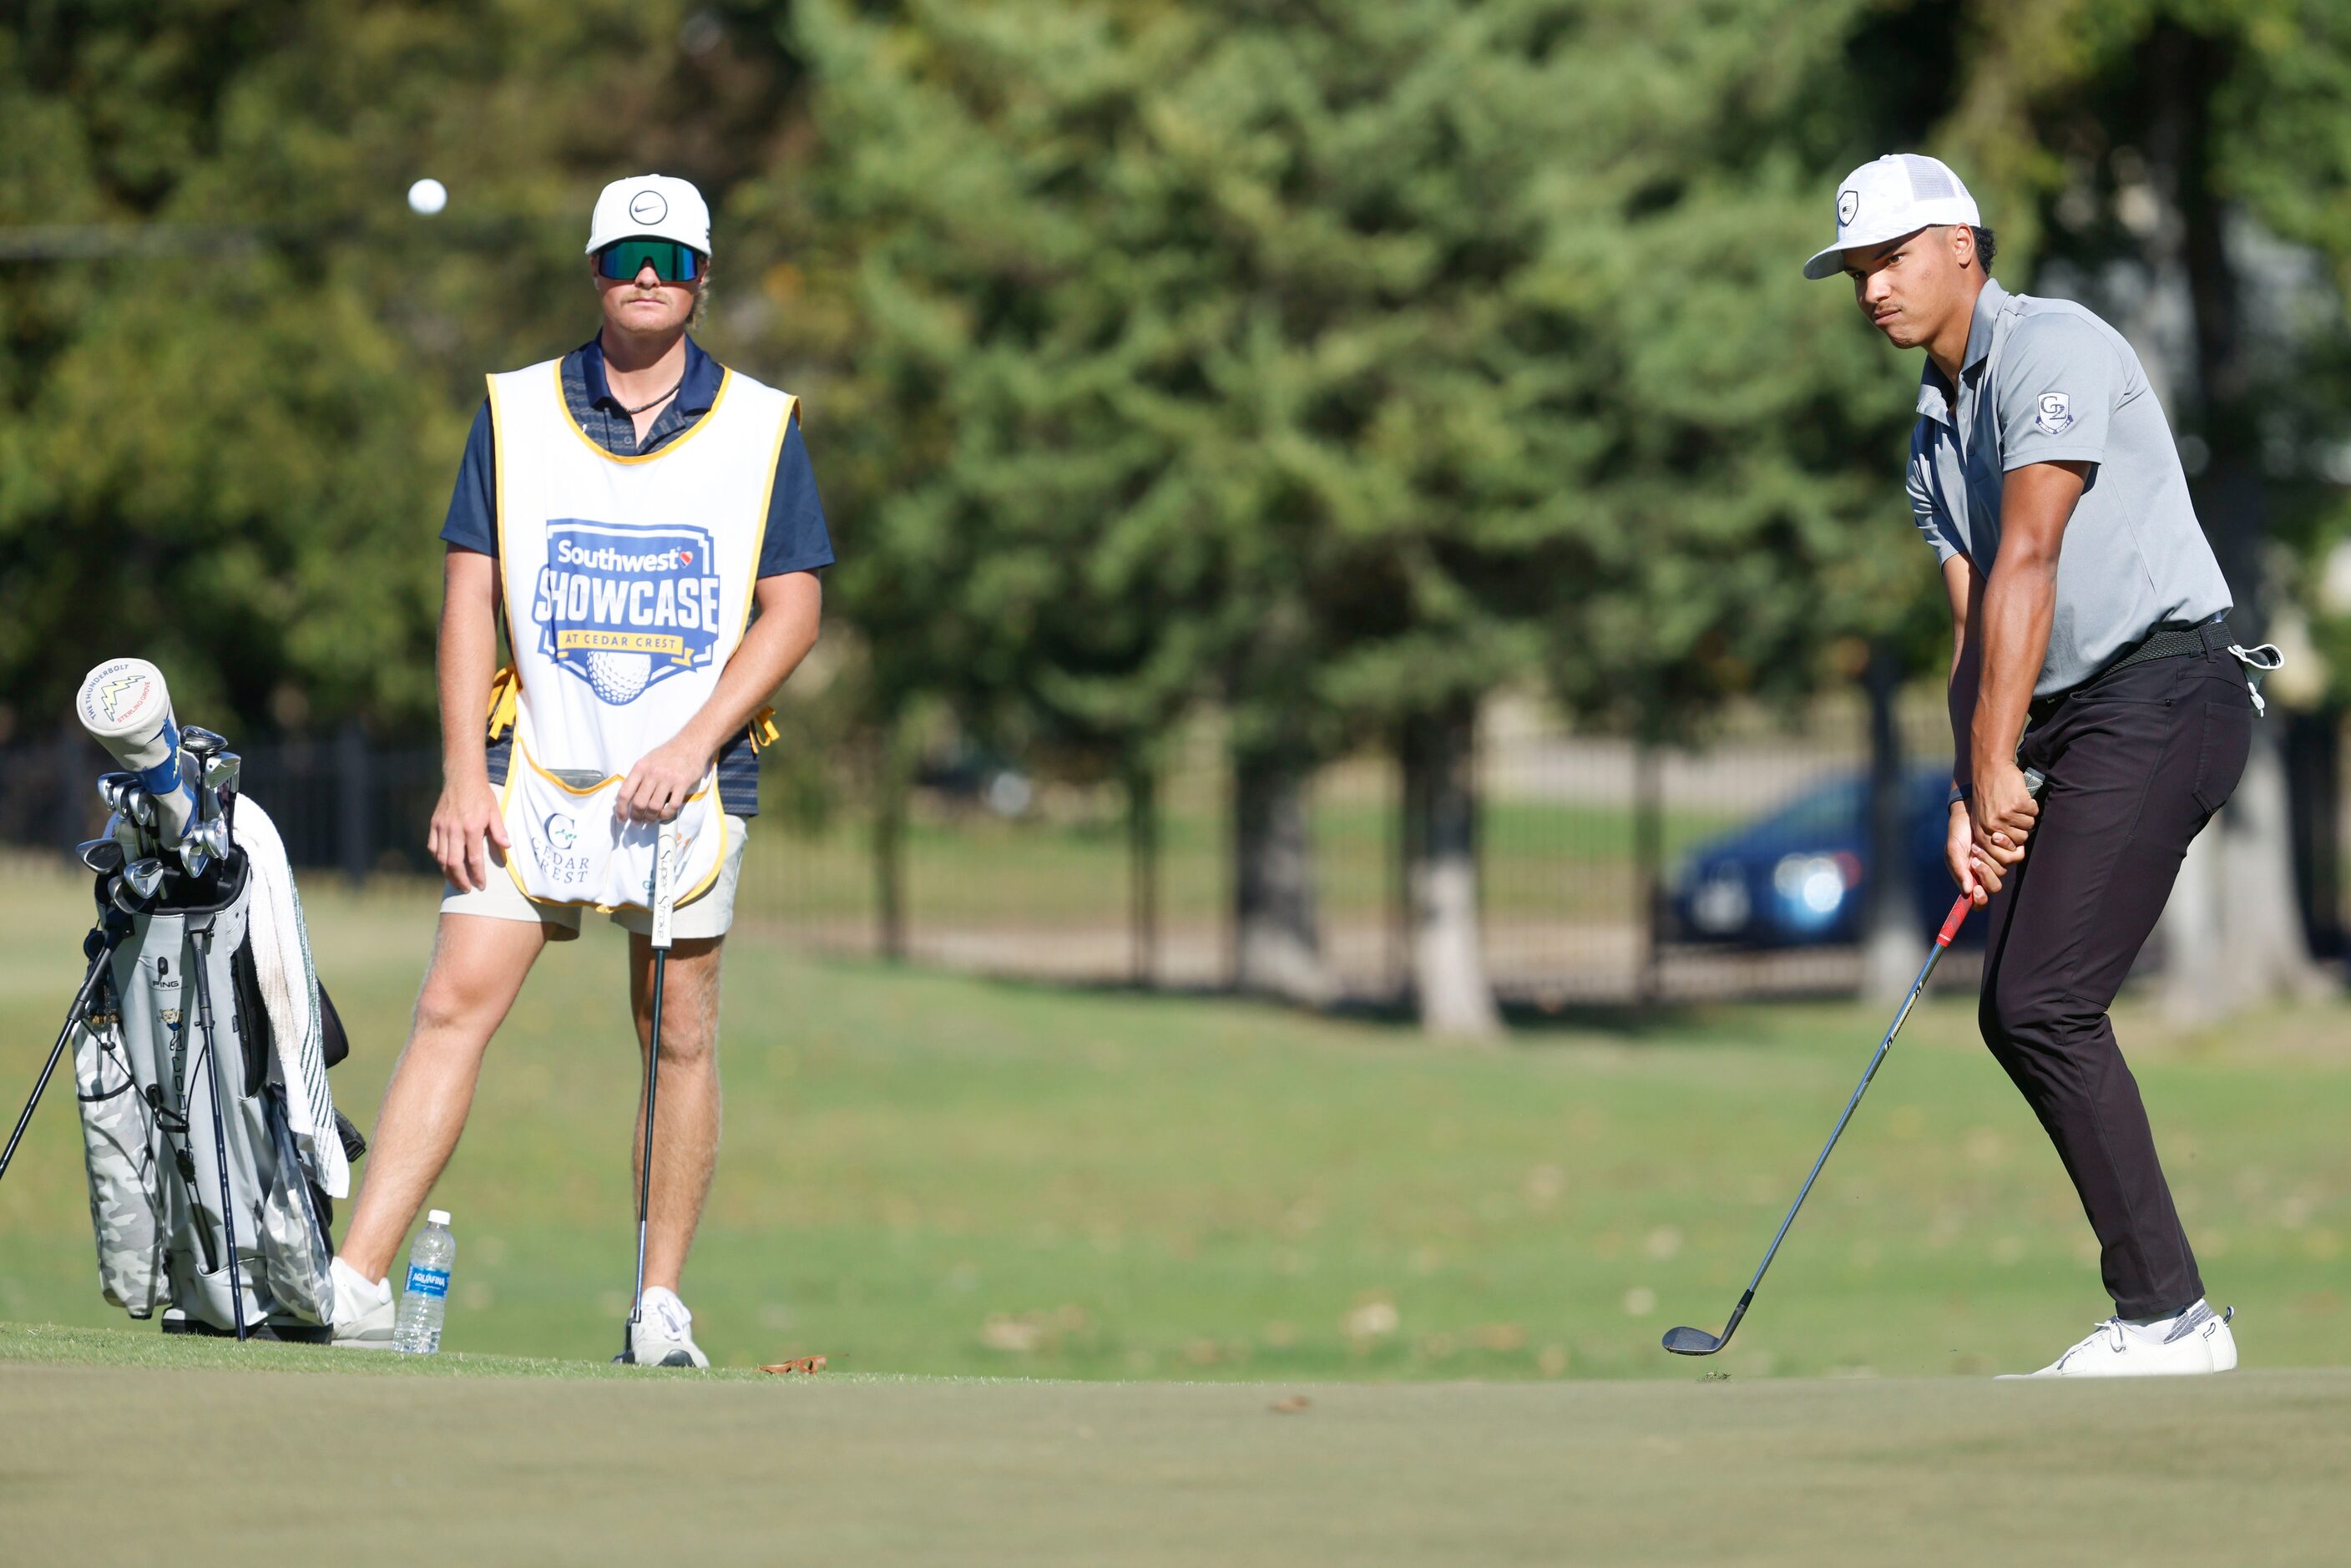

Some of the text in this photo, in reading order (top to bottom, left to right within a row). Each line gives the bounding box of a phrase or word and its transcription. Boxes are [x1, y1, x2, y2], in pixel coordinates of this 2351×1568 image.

[557, 539, 679, 573] Southwest
[534, 567, 720, 634] SHOWCASE
[565, 634, 675, 649] AT CEDAR CREST
[85, 664, 129, 720] THE THUNDERBOLT
[117, 680, 150, 723] STERLING GROVE
[531, 837, 589, 869] CEDAR
[534, 851, 588, 883] REST
[412, 1272, 445, 1287] AQUAFINA
